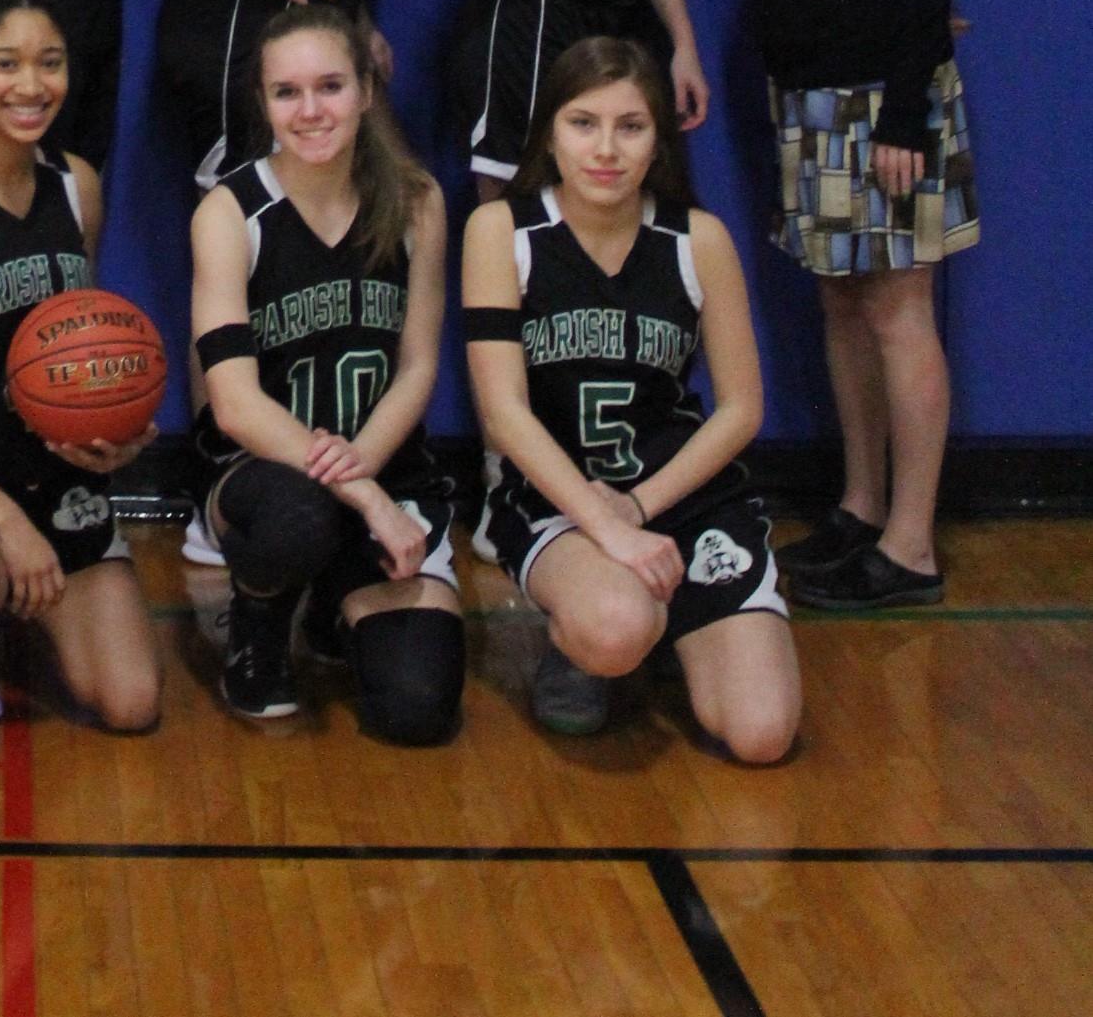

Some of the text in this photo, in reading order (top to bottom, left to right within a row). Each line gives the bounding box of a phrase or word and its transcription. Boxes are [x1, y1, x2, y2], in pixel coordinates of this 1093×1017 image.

[36, 311, 146, 349] SPALDING
[521, 308, 627, 366] PARISH
[286, 349, 389, 441] 10
[579, 382, 644, 481] 5
